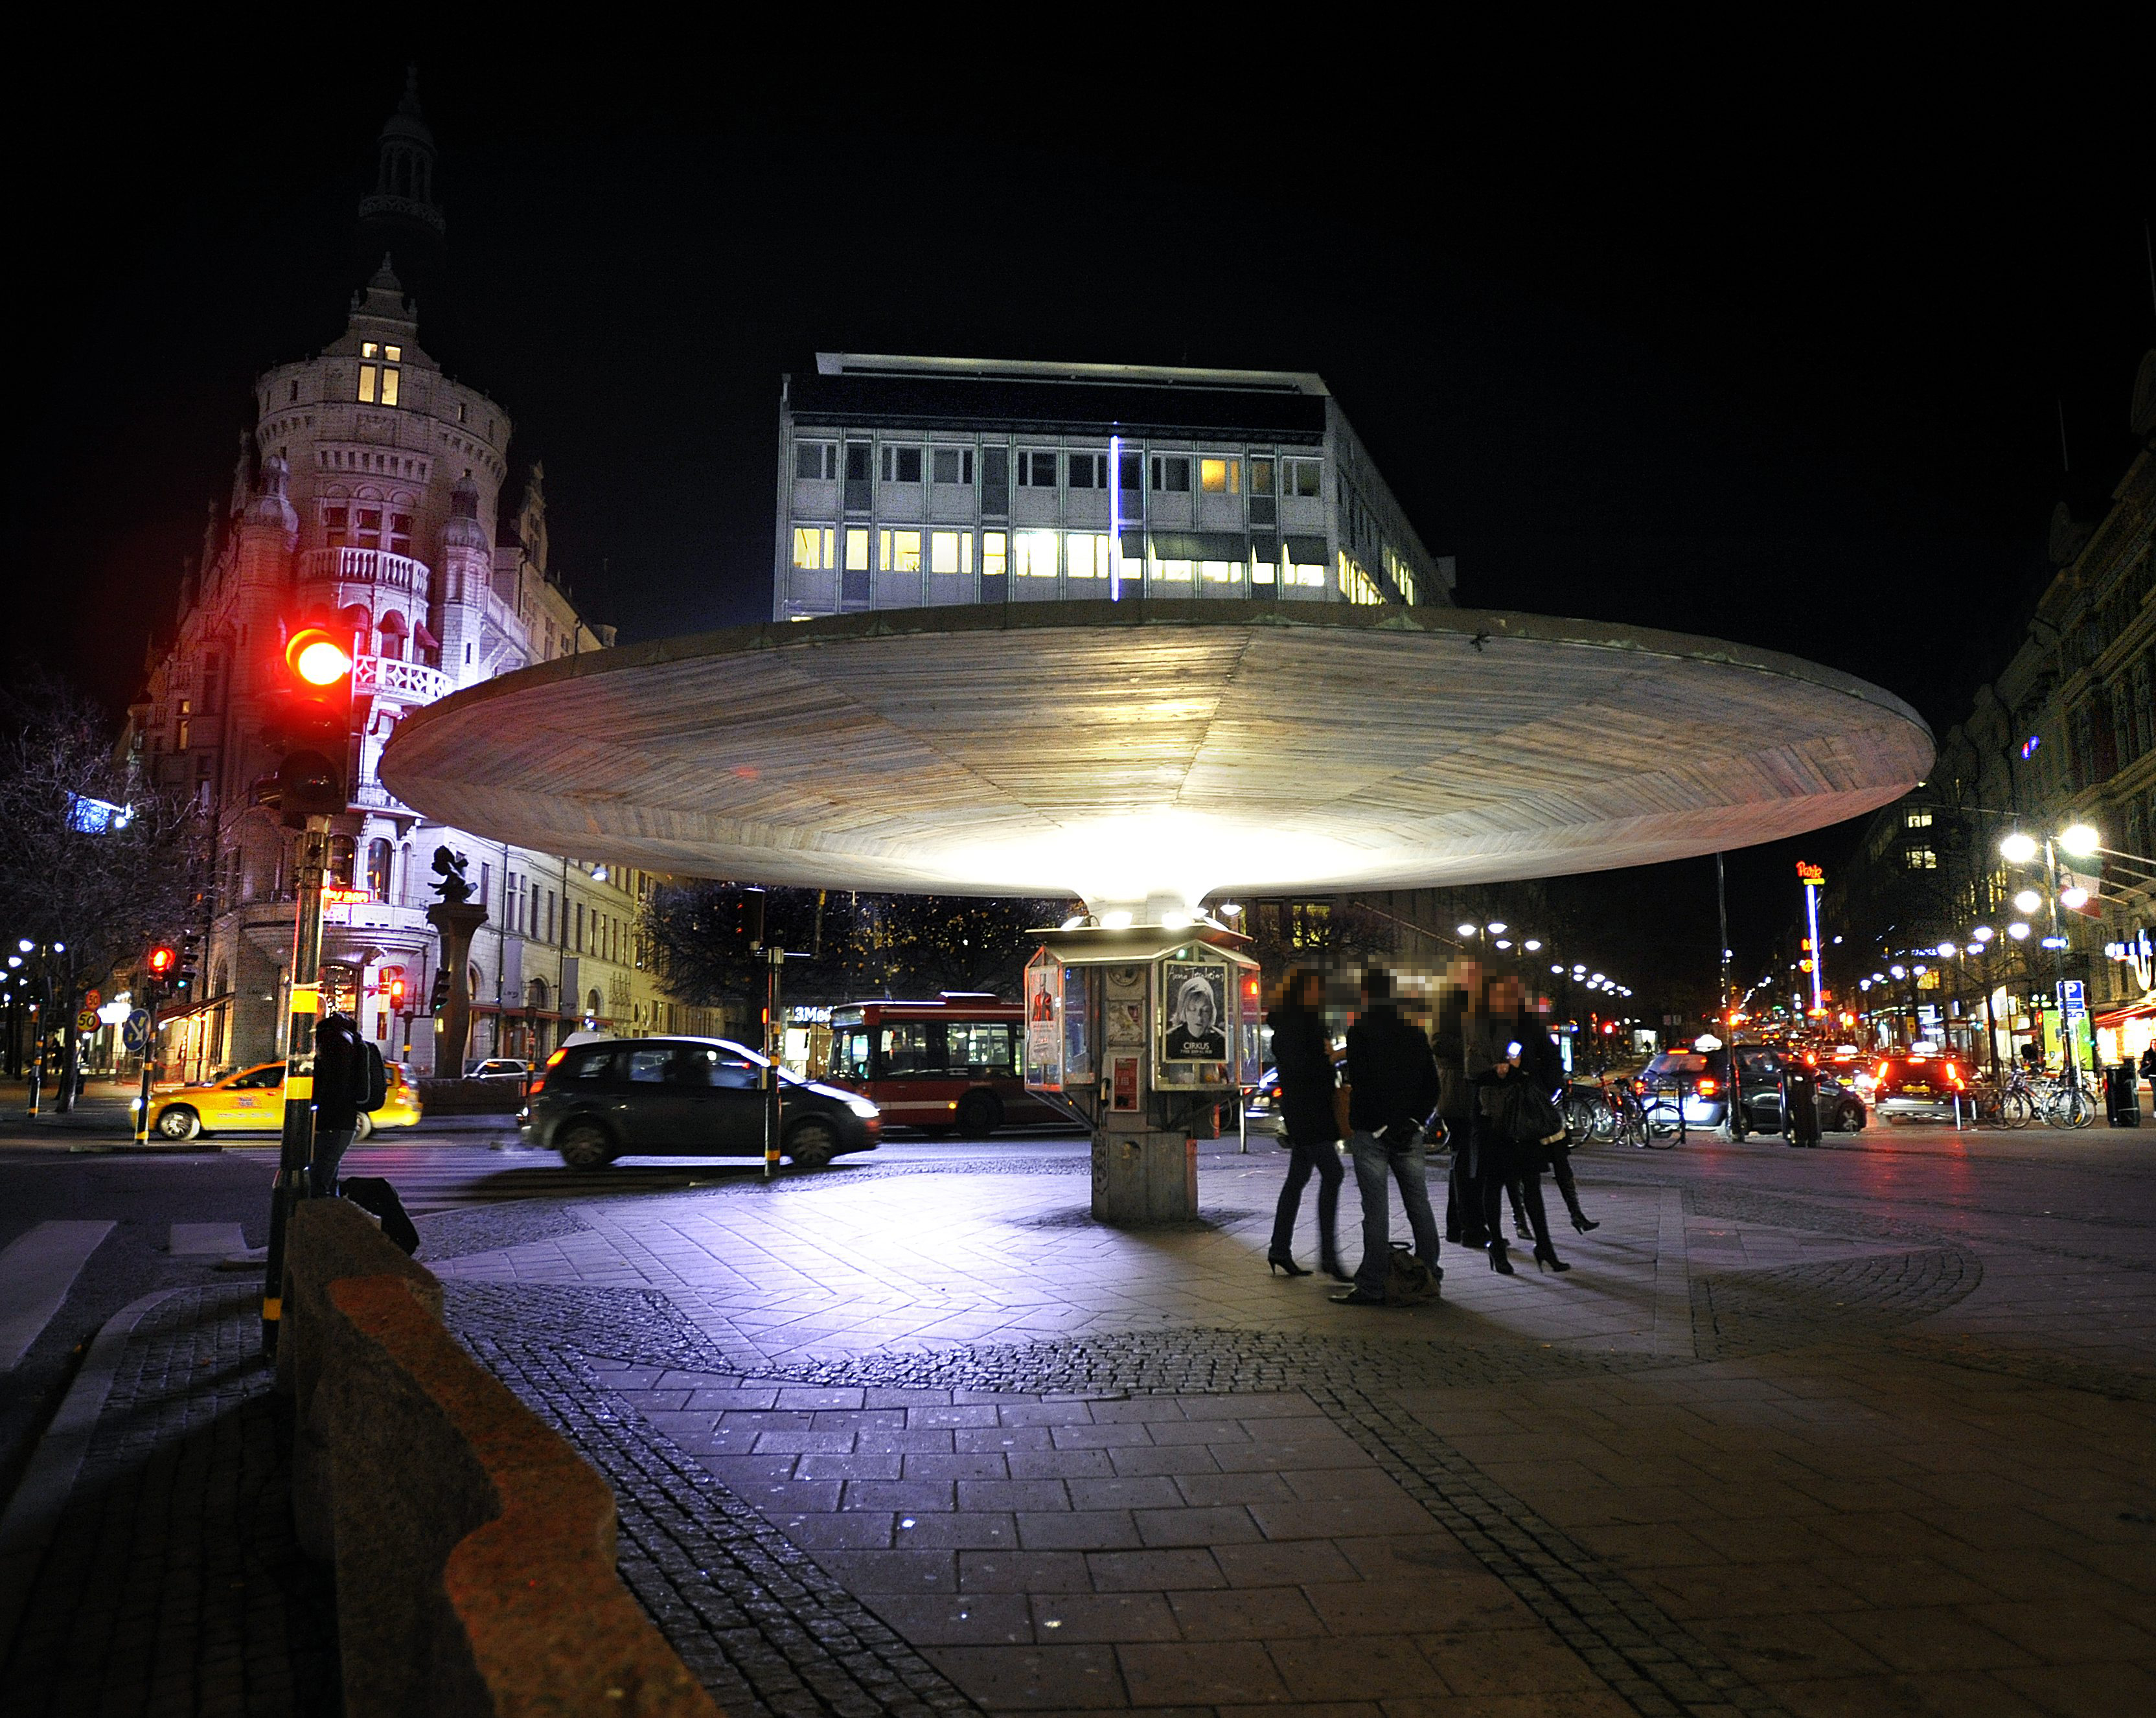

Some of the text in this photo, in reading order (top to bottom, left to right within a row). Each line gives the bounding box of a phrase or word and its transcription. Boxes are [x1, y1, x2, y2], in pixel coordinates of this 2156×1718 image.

[1796, 860, 1822, 879] Park
[2064, 983, 2078, 998] P
[89, 994, 98, 1005] 50
[78, 1013, 96, 1027] 50
[1184, 1042, 1210, 1050] CIRKUS
